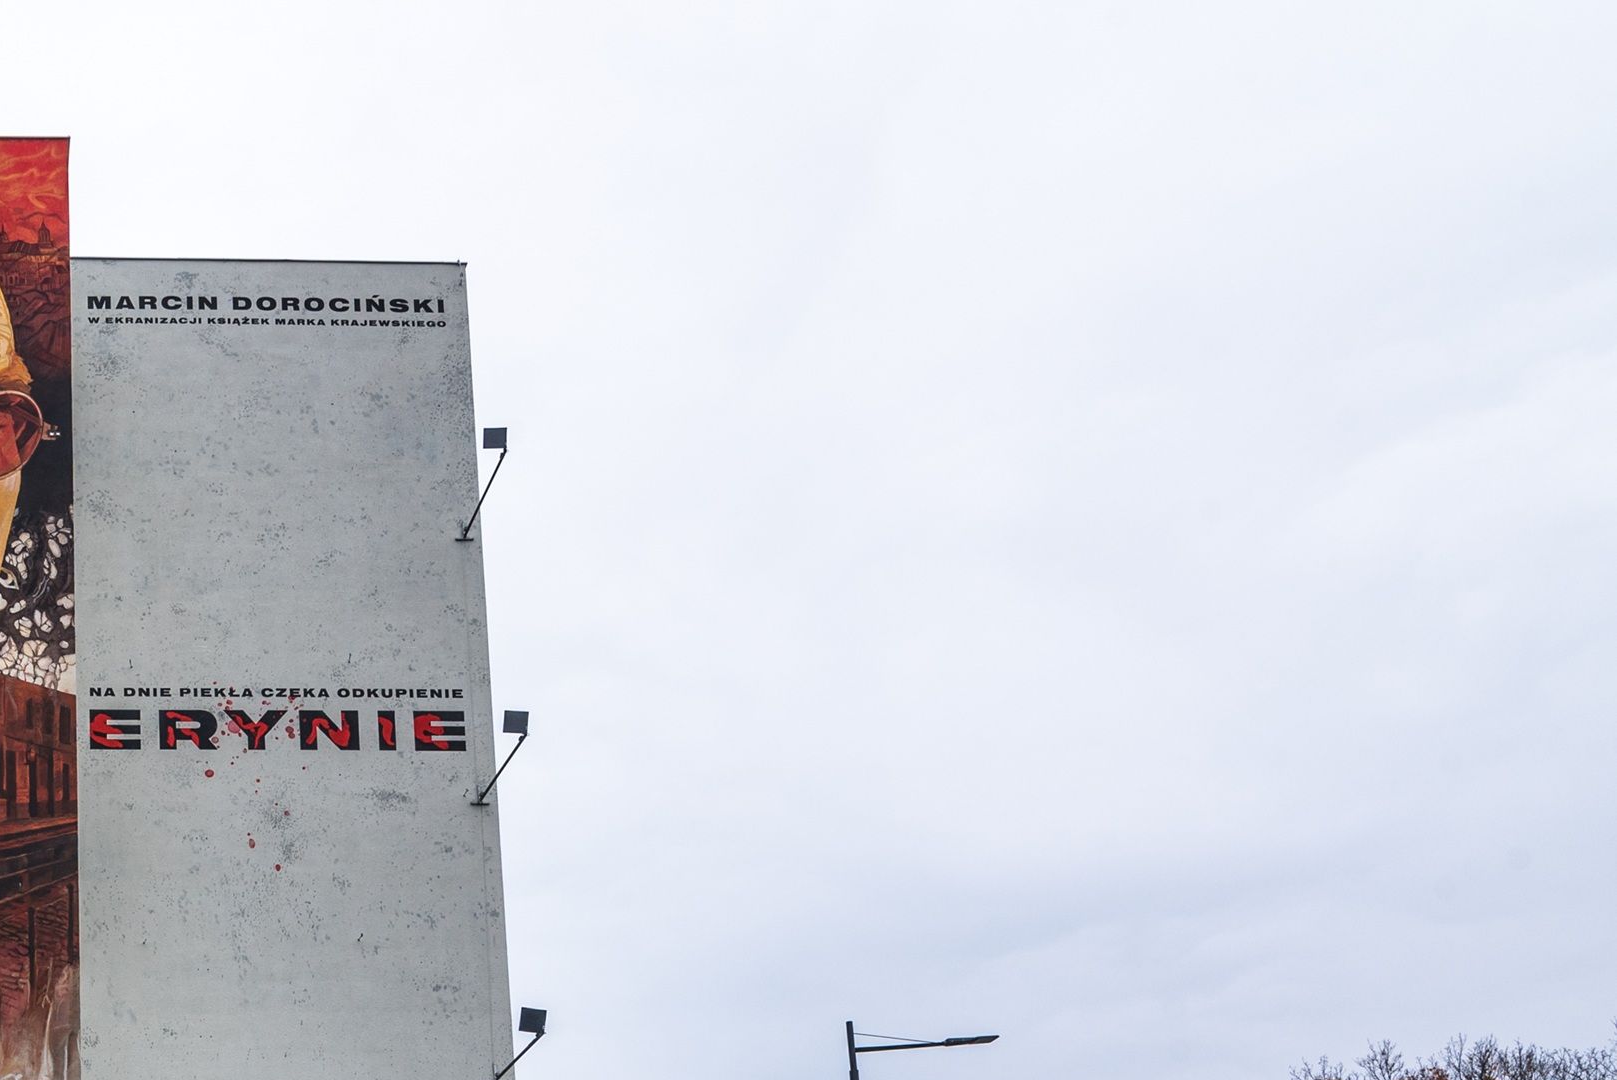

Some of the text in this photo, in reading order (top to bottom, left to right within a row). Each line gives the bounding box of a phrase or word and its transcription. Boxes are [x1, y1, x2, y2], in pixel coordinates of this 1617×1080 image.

[87, 293, 446, 313] MARCIN DOROCIŃSKI
[104, 316, 203, 325] EKRANIZACJI
[207, 316, 271, 327] KSIĄŻEK
[275, 318, 327, 326] MARKA
[330, 318, 447, 328] KRAJEWSKIEGO
[89, 687, 464, 699] NA DNIE PIEKŁA CZEKA ODKUPIENIE
[89, 709, 466, 752] ERYNIE
